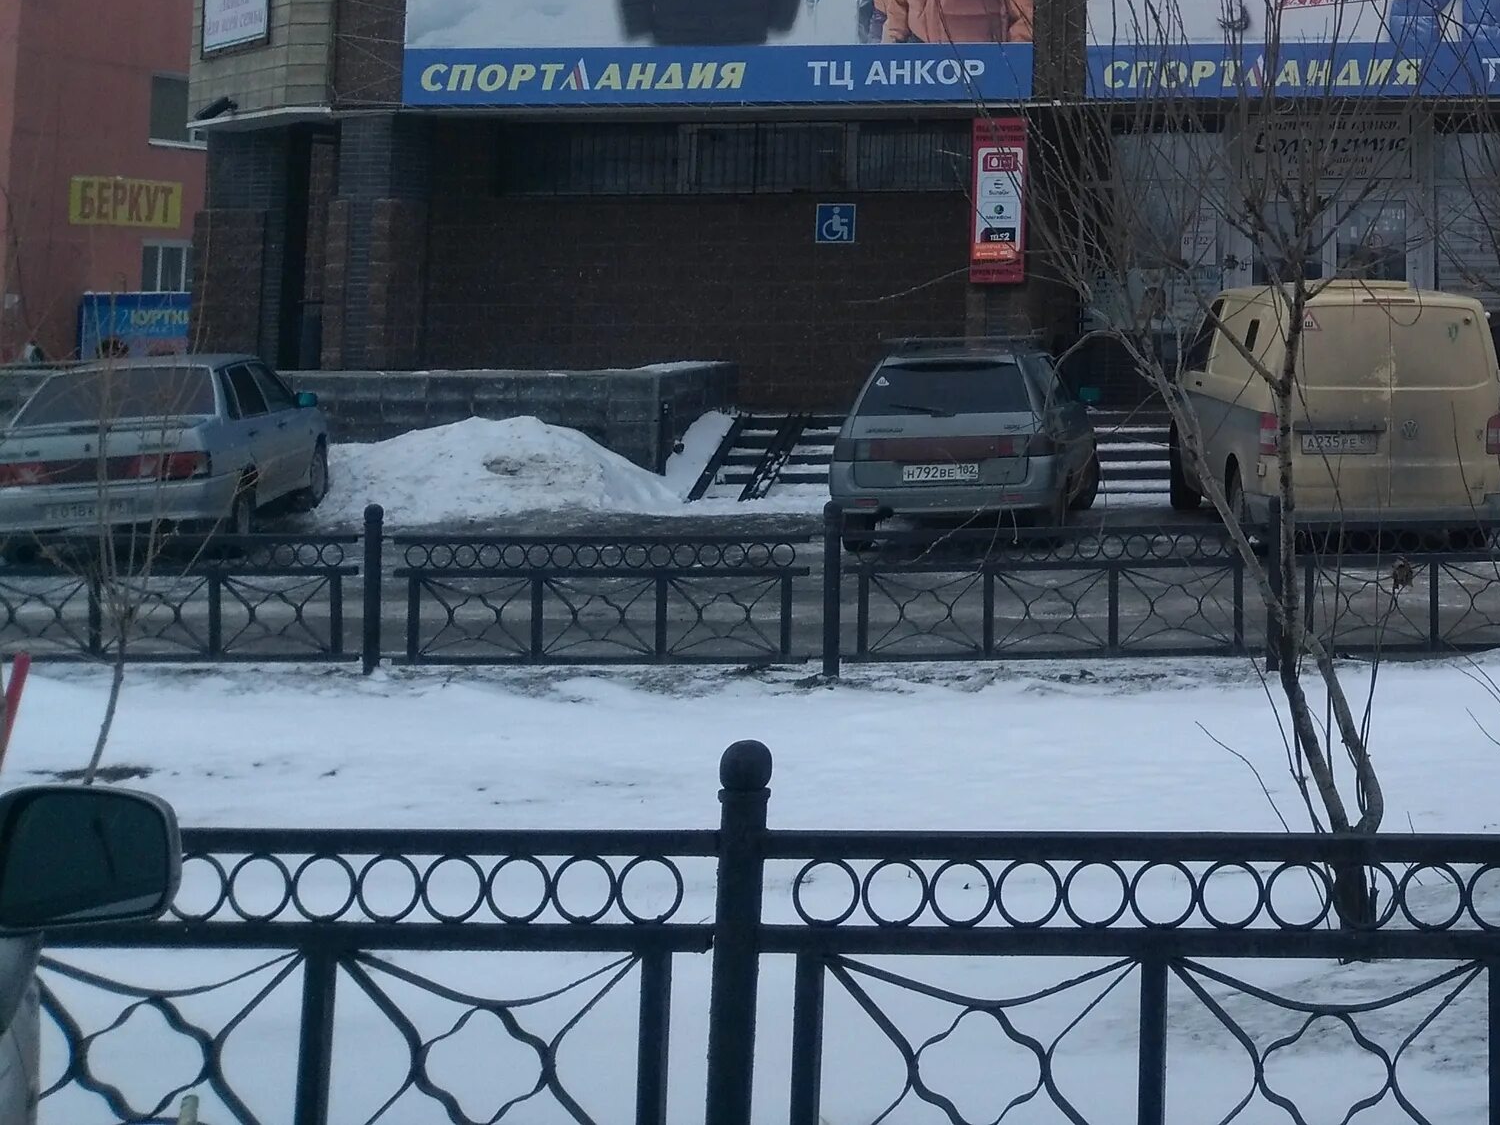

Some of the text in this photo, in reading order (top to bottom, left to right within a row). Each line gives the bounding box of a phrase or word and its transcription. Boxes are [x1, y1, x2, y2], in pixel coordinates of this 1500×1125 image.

[420, 57, 986, 92] СПОРТЛАНДИЯ ТЦ АНКОР
[1103, 56, 1421, 89] СПОРТЛАНДИЯ
[79, 180, 173, 223] БЕРКУТ
[906, 466, 954, 481] Н792ВЕ
